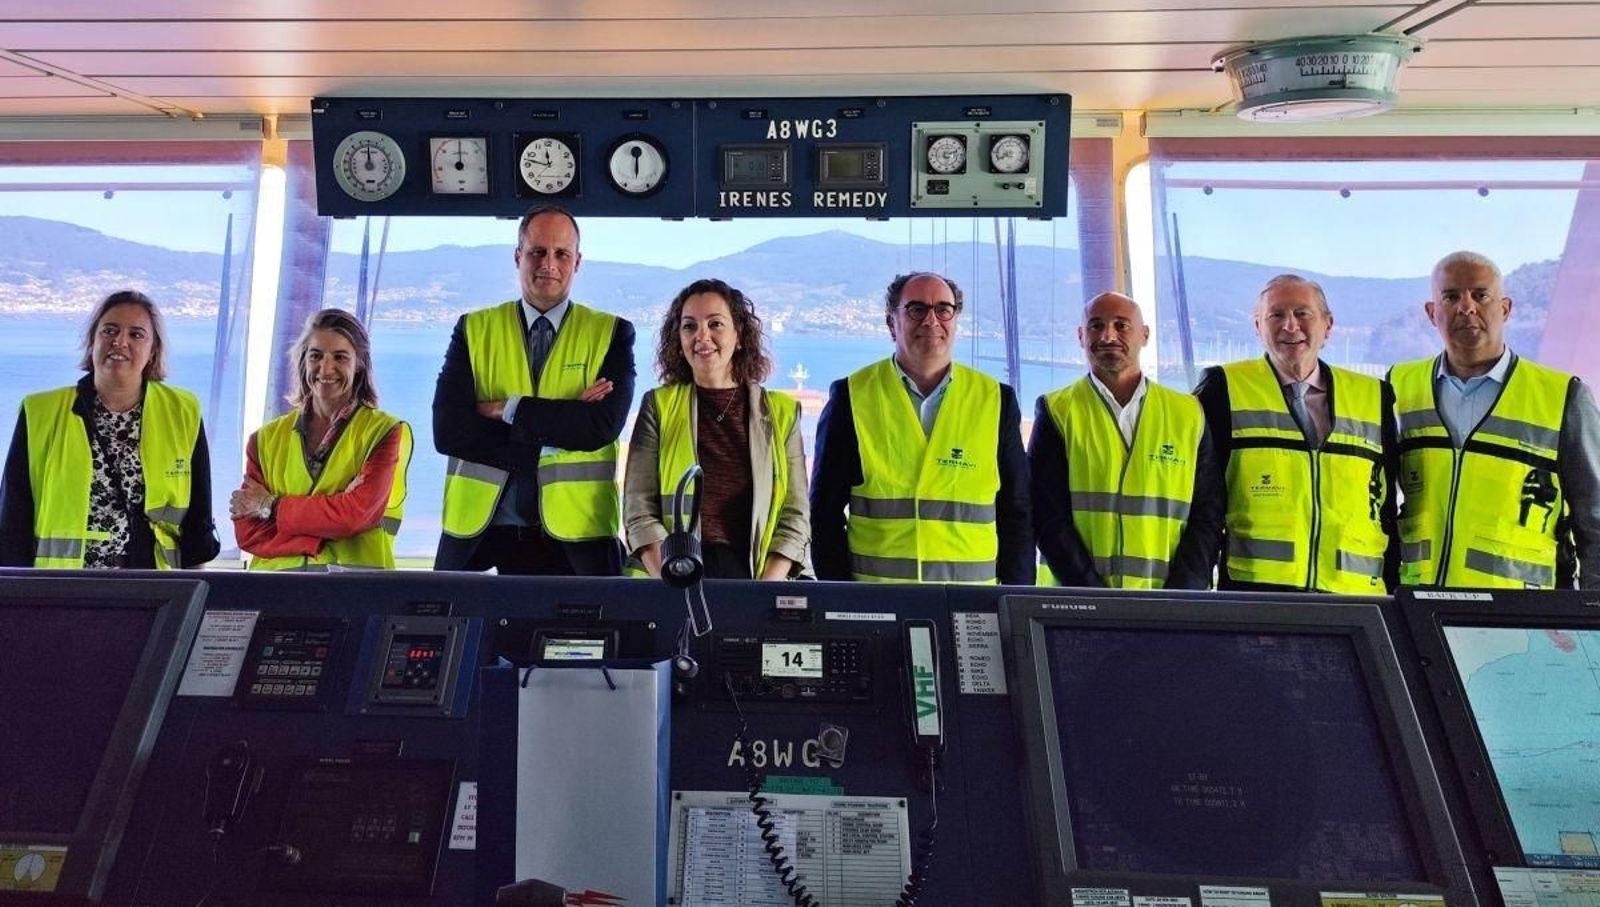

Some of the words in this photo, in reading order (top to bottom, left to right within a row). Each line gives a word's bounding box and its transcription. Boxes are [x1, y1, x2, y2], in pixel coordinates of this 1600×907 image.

[1306, 55, 1317, 65] 30
[1317, 55, 1329, 65] 20
[1330, 54, 1339, 65] 10
[1342, 54, 1349, 65] 0
[766, 118, 837, 139] A8WG3
[719, 191, 792, 207] IRENES
[813, 191, 888, 208] REMEDY
[1041, 603, 1097, 611] FURUNO
[781, 651, 804, 668] 14
[912, 664, 938, 719] VHF
